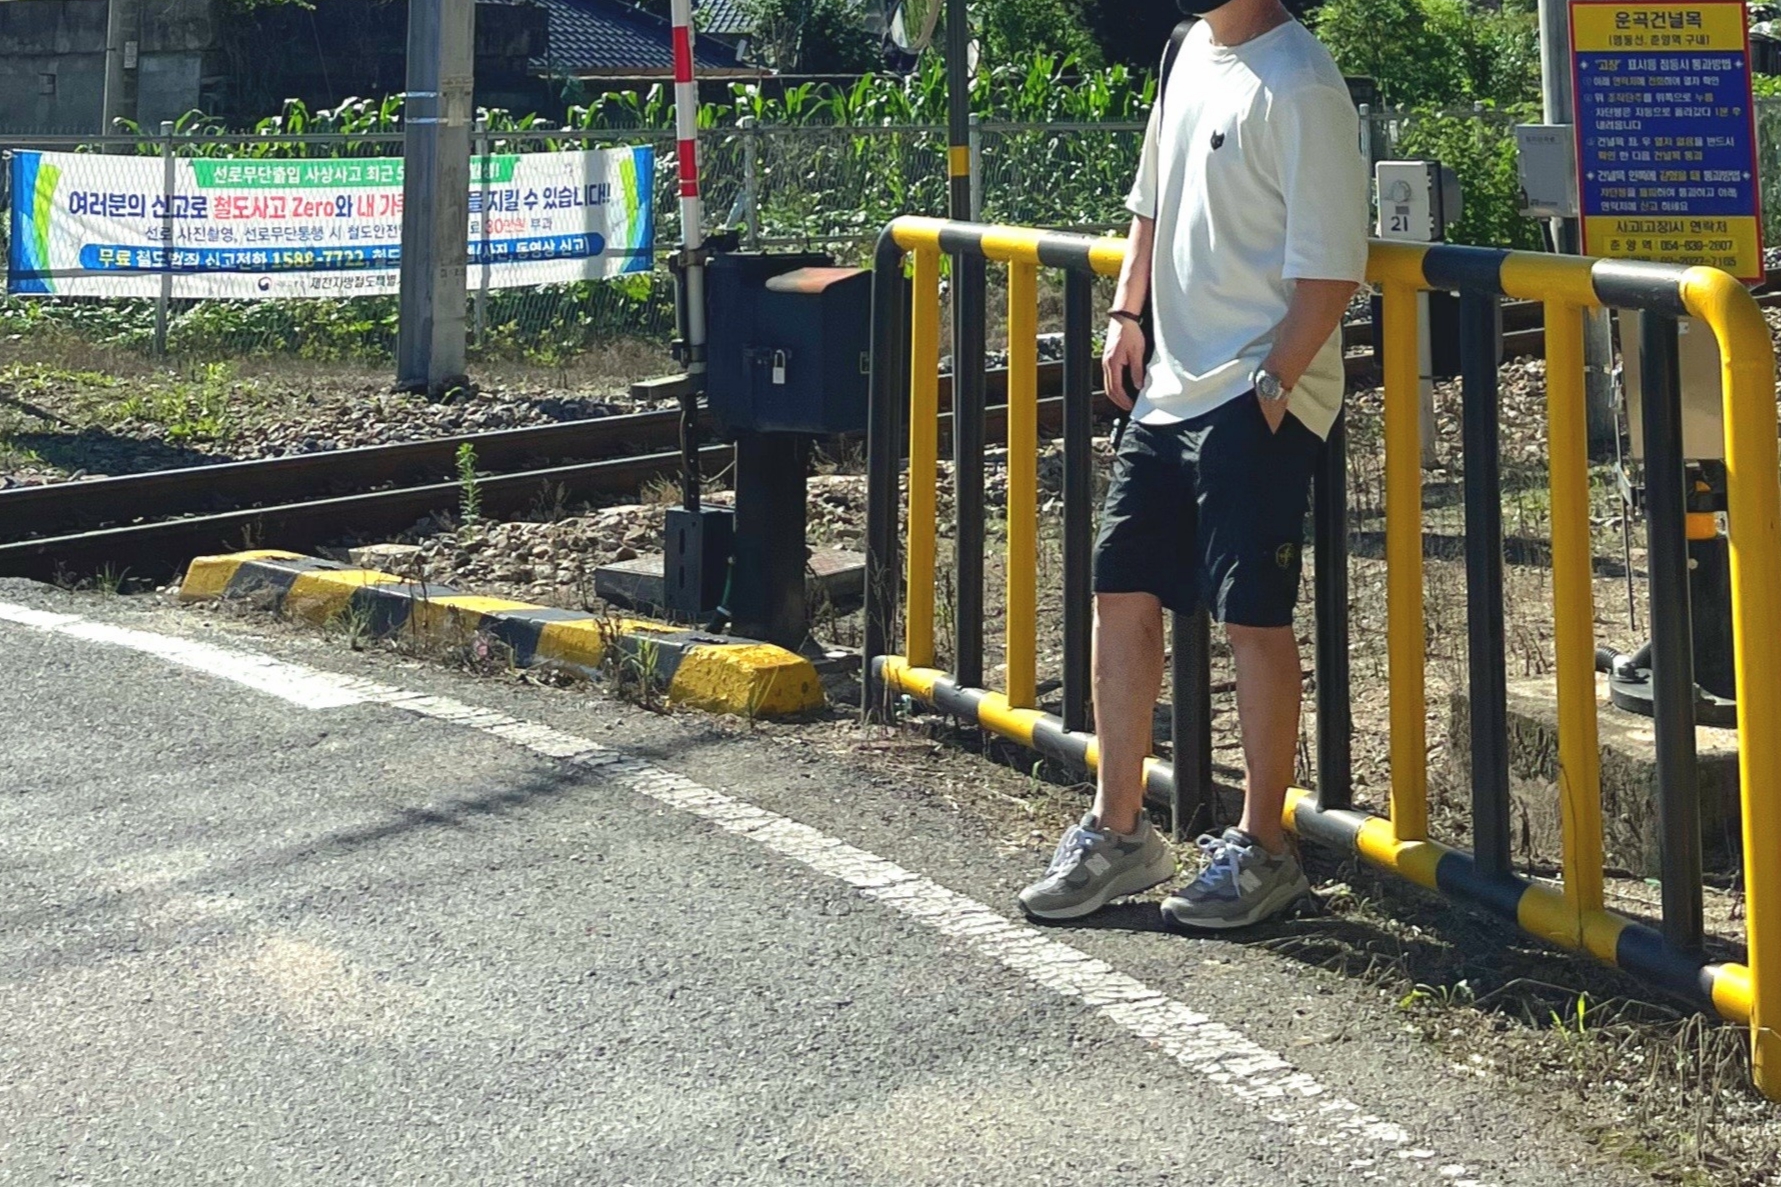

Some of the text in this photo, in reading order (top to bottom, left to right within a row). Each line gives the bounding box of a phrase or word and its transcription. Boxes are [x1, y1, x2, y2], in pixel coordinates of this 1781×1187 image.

[1615, 11, 1702, 29] 운곡건널목
[1692, 59, 1732, 70] 통과방법
[214, 166, 301, 184] 선로무단출입
[305, 166, 362, 183] 사상사고
[366, 165, 394, 182] 최근
[69, 191, 145, 219] 여러분의
[151, 194, 208, 220] 신고로
[214, 195, 286, 220] 철도사고
[357, 194, 375, 218] 내
[487, 189, 519, 212] 지킬
[524, 188, 538, 210] 수
[147, 226, 172, 243] 선로
[244, 226, 324, 242] 선로무단통행
[329, 225, 341, 241] 시
[531, 217, 552, 231] 부과
[1391, 216, 1408, 232] 21
[1690, 220, 1727, 233] 연락처
[99, 249, 131, 267] 무료
[205, 250, 267, 269] 신고전화
[516, 241, 556, 259] 동영상
